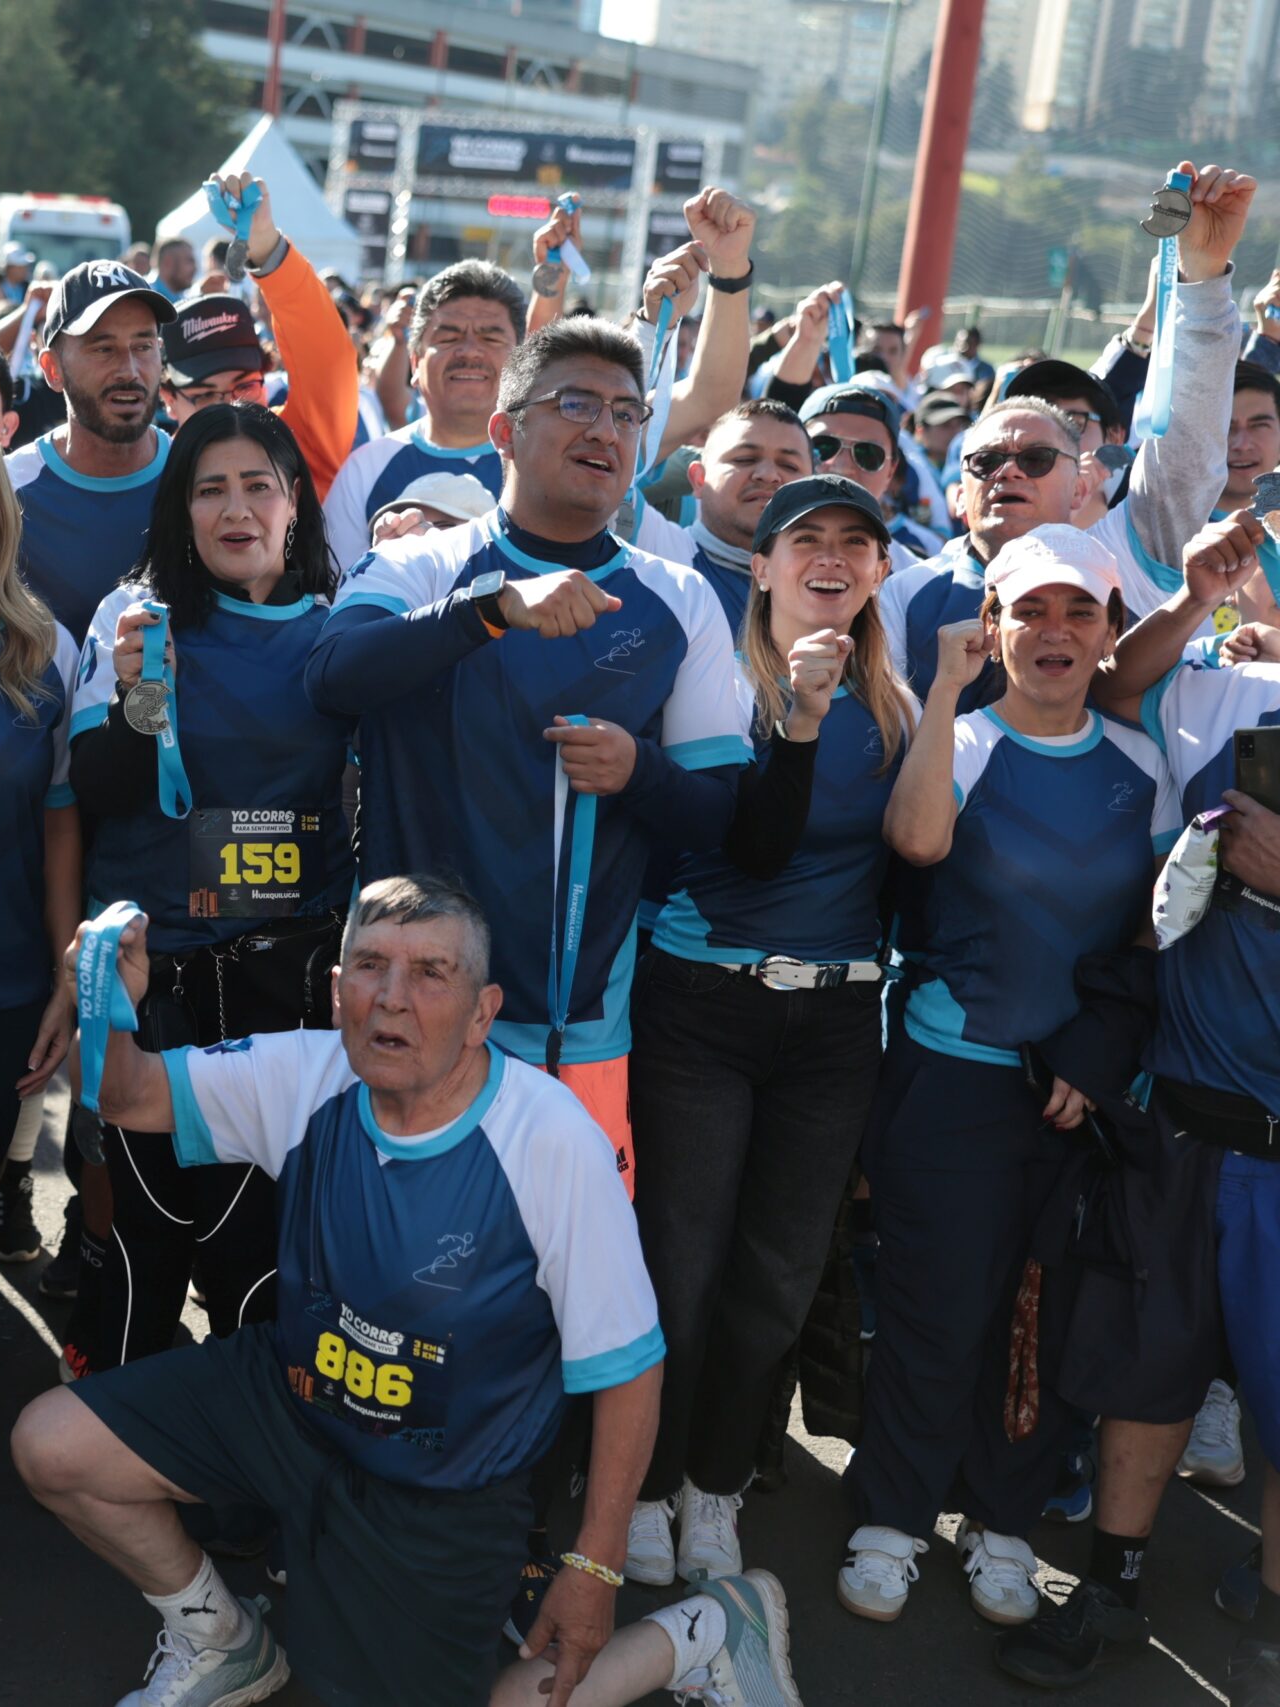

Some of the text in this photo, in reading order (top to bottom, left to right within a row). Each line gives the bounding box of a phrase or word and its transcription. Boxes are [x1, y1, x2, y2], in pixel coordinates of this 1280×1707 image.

[181, 312, 240, 338] Milwaukee
[231, 810, 249, 823] YO
[220, 843, 301, 884] 159
[81, 998, 93, 1019] YO
[340, 1303, 354, 1322] YO
[377, 1345, 394, 1354] VIVO
[413, 1339, 421, 1348] 3
[315, 1331, 414, 1407] 886
